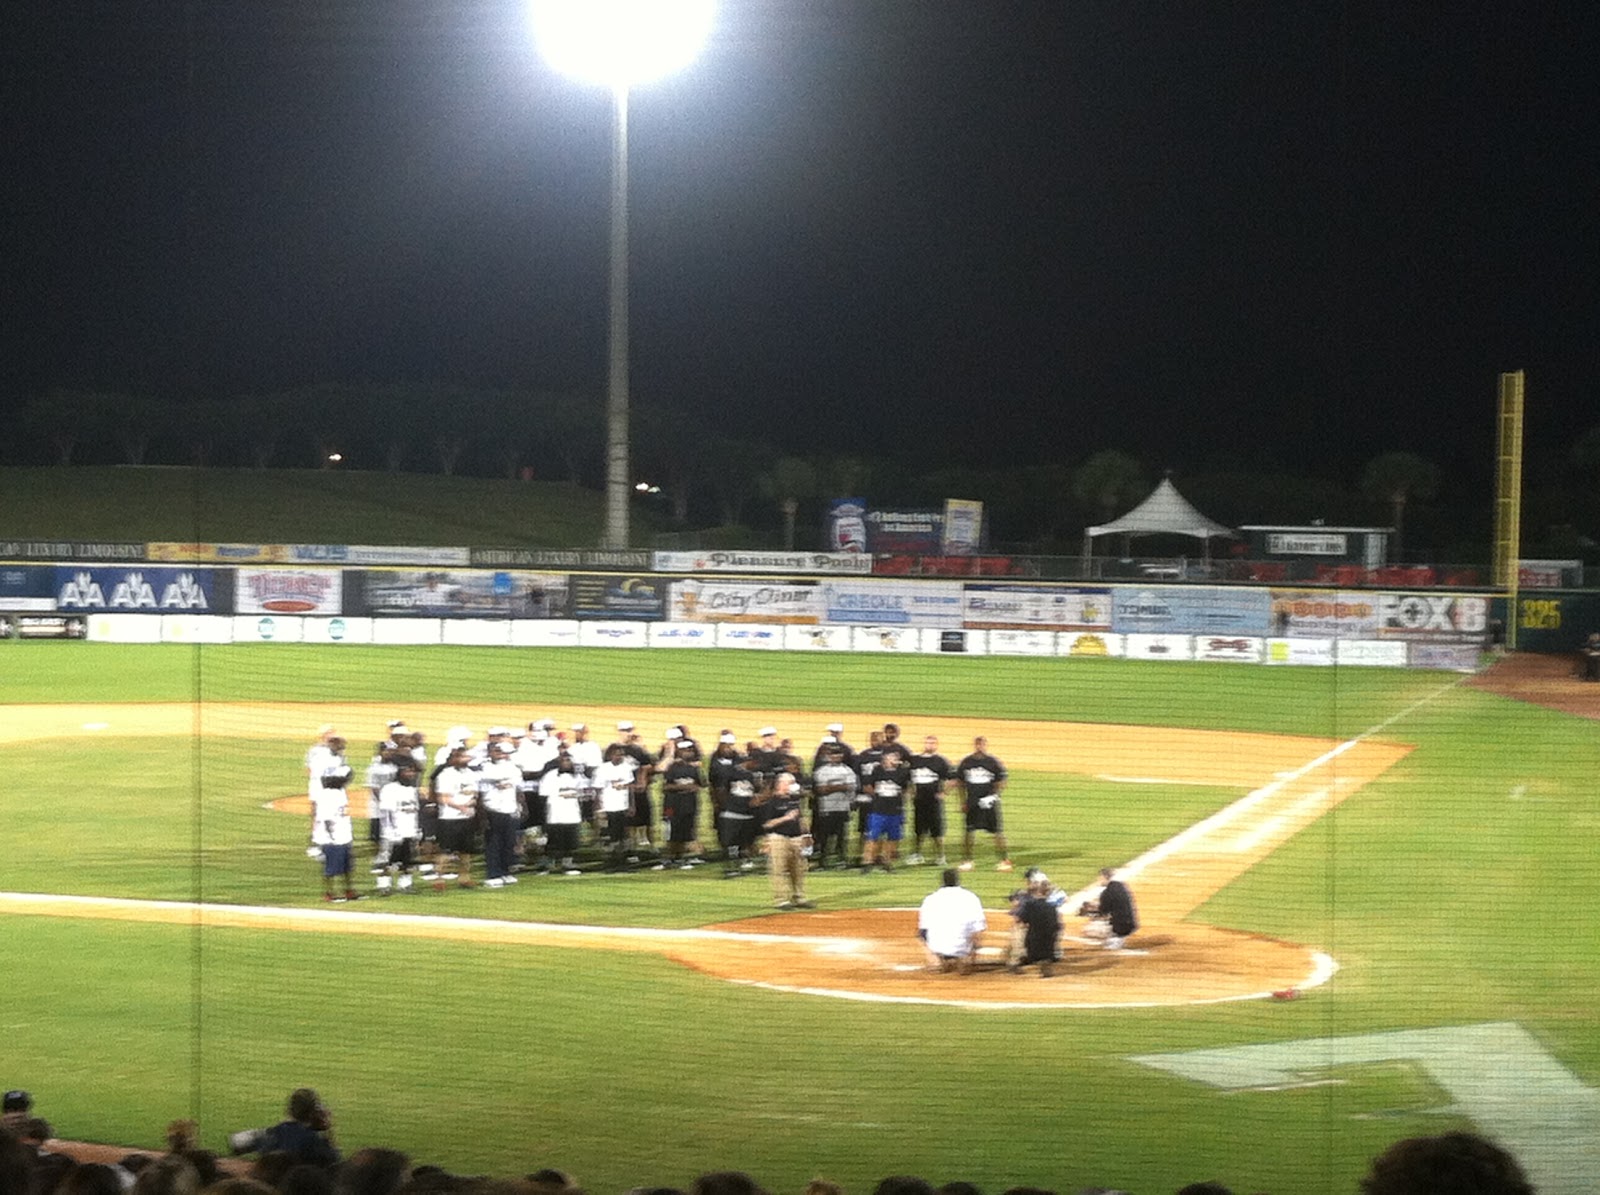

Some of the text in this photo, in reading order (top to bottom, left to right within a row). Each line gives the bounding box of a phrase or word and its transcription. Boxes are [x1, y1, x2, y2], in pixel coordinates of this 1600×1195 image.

[708, 552, 806, 567] Pleasure
[711, 587, 813, 616] City Diner
